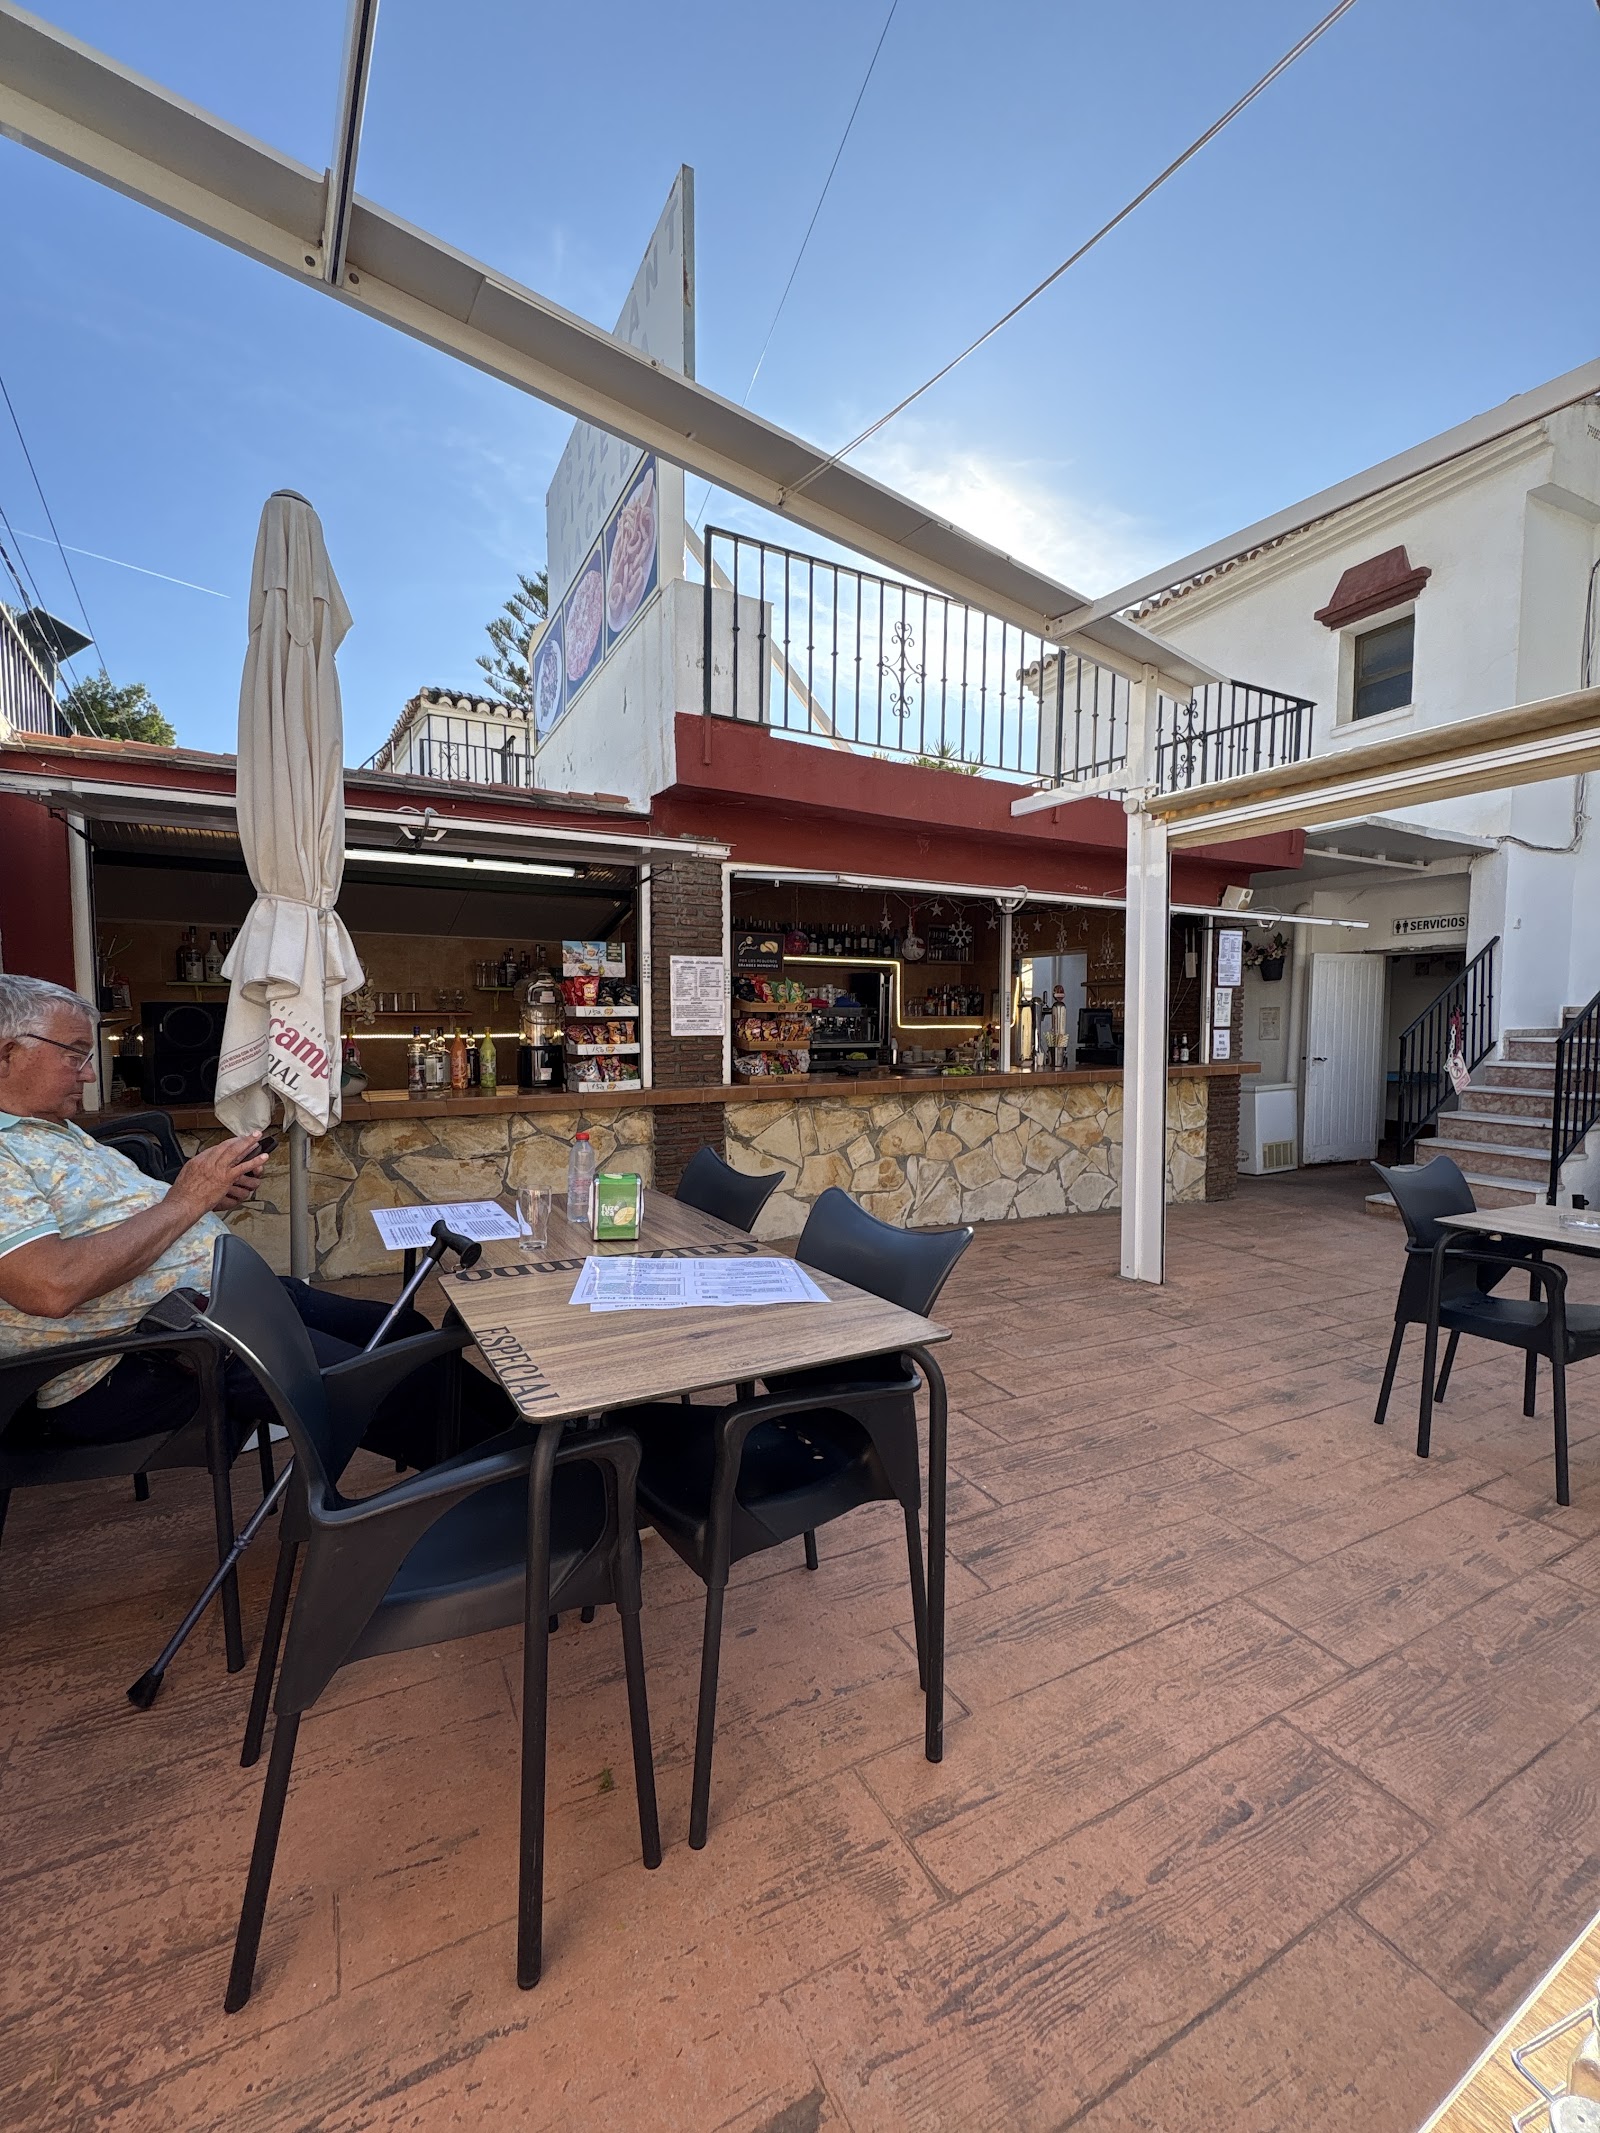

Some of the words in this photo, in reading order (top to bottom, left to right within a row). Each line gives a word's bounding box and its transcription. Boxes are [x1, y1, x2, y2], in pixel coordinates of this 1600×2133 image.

[1410, 917, 1466, 931] SERVICIOS
[269, 1018, 329, 1080] camp
[268, 1053, 301, 1090] IAL
[601, 1203, 619, 1212] fuze
[601, 1209, 615, 1217] tea
[474, 1326, 561, 1411] ESPECIAL
